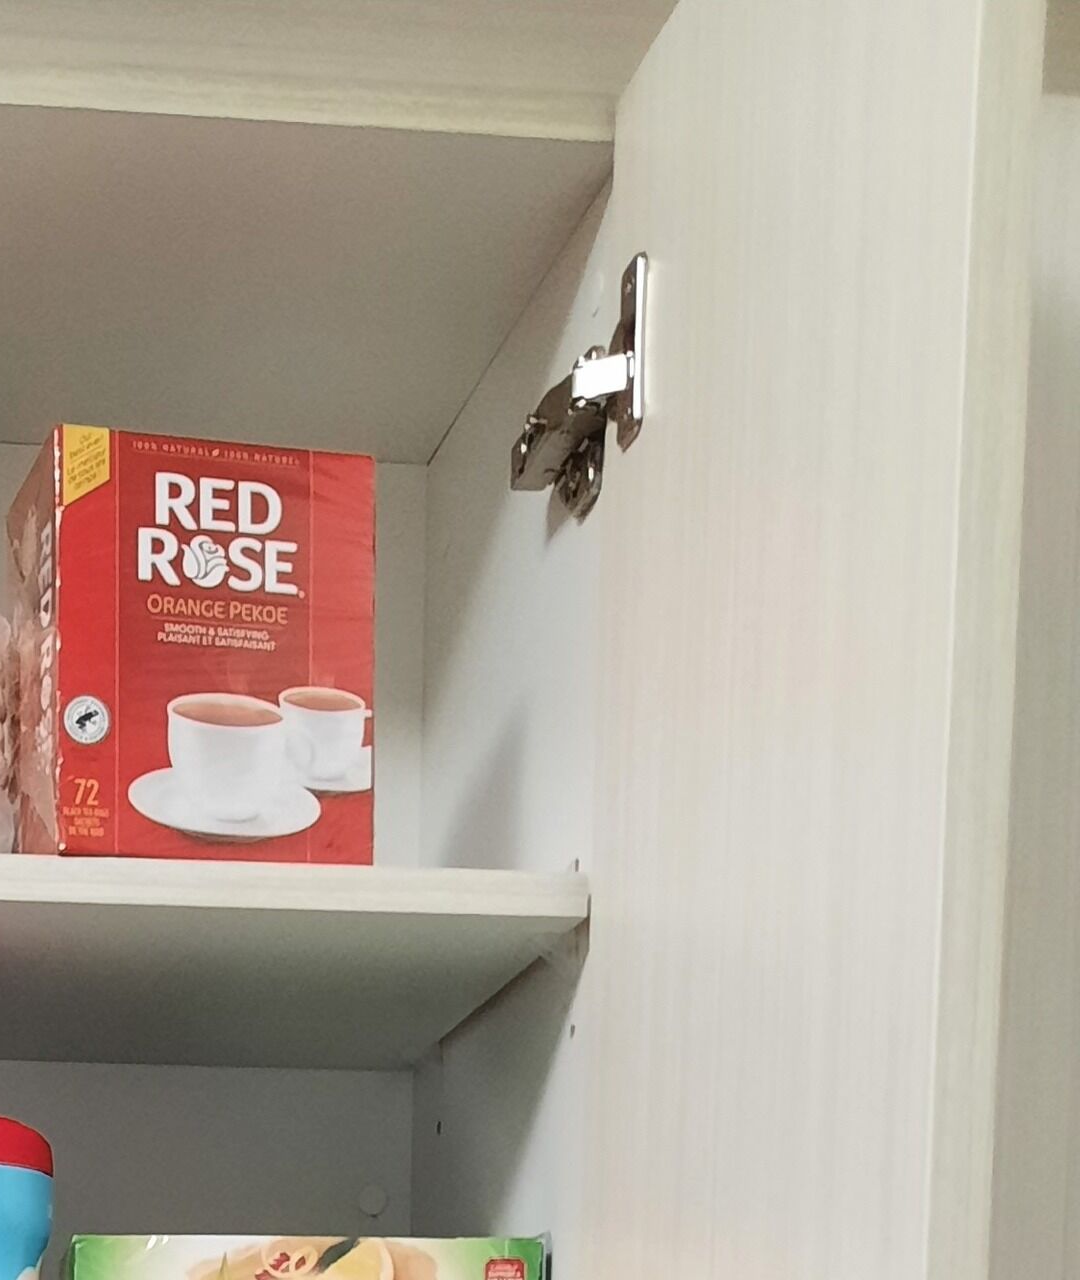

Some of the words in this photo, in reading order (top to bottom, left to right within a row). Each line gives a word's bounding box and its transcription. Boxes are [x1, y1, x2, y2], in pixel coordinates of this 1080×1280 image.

[155, 471, 283, 535] RED
[137, 526, 299, 595] ROSE
[147, 593, 225, 619] ORANGE
[229, 601, 288, 625] PEKOE
[157, 631, 201, 645] PLAISANT
[164, 622, 207, 635] SMOOTH
[217, 626, 270, 641] SATISFYING
[73, 778, 99, 806] 72
